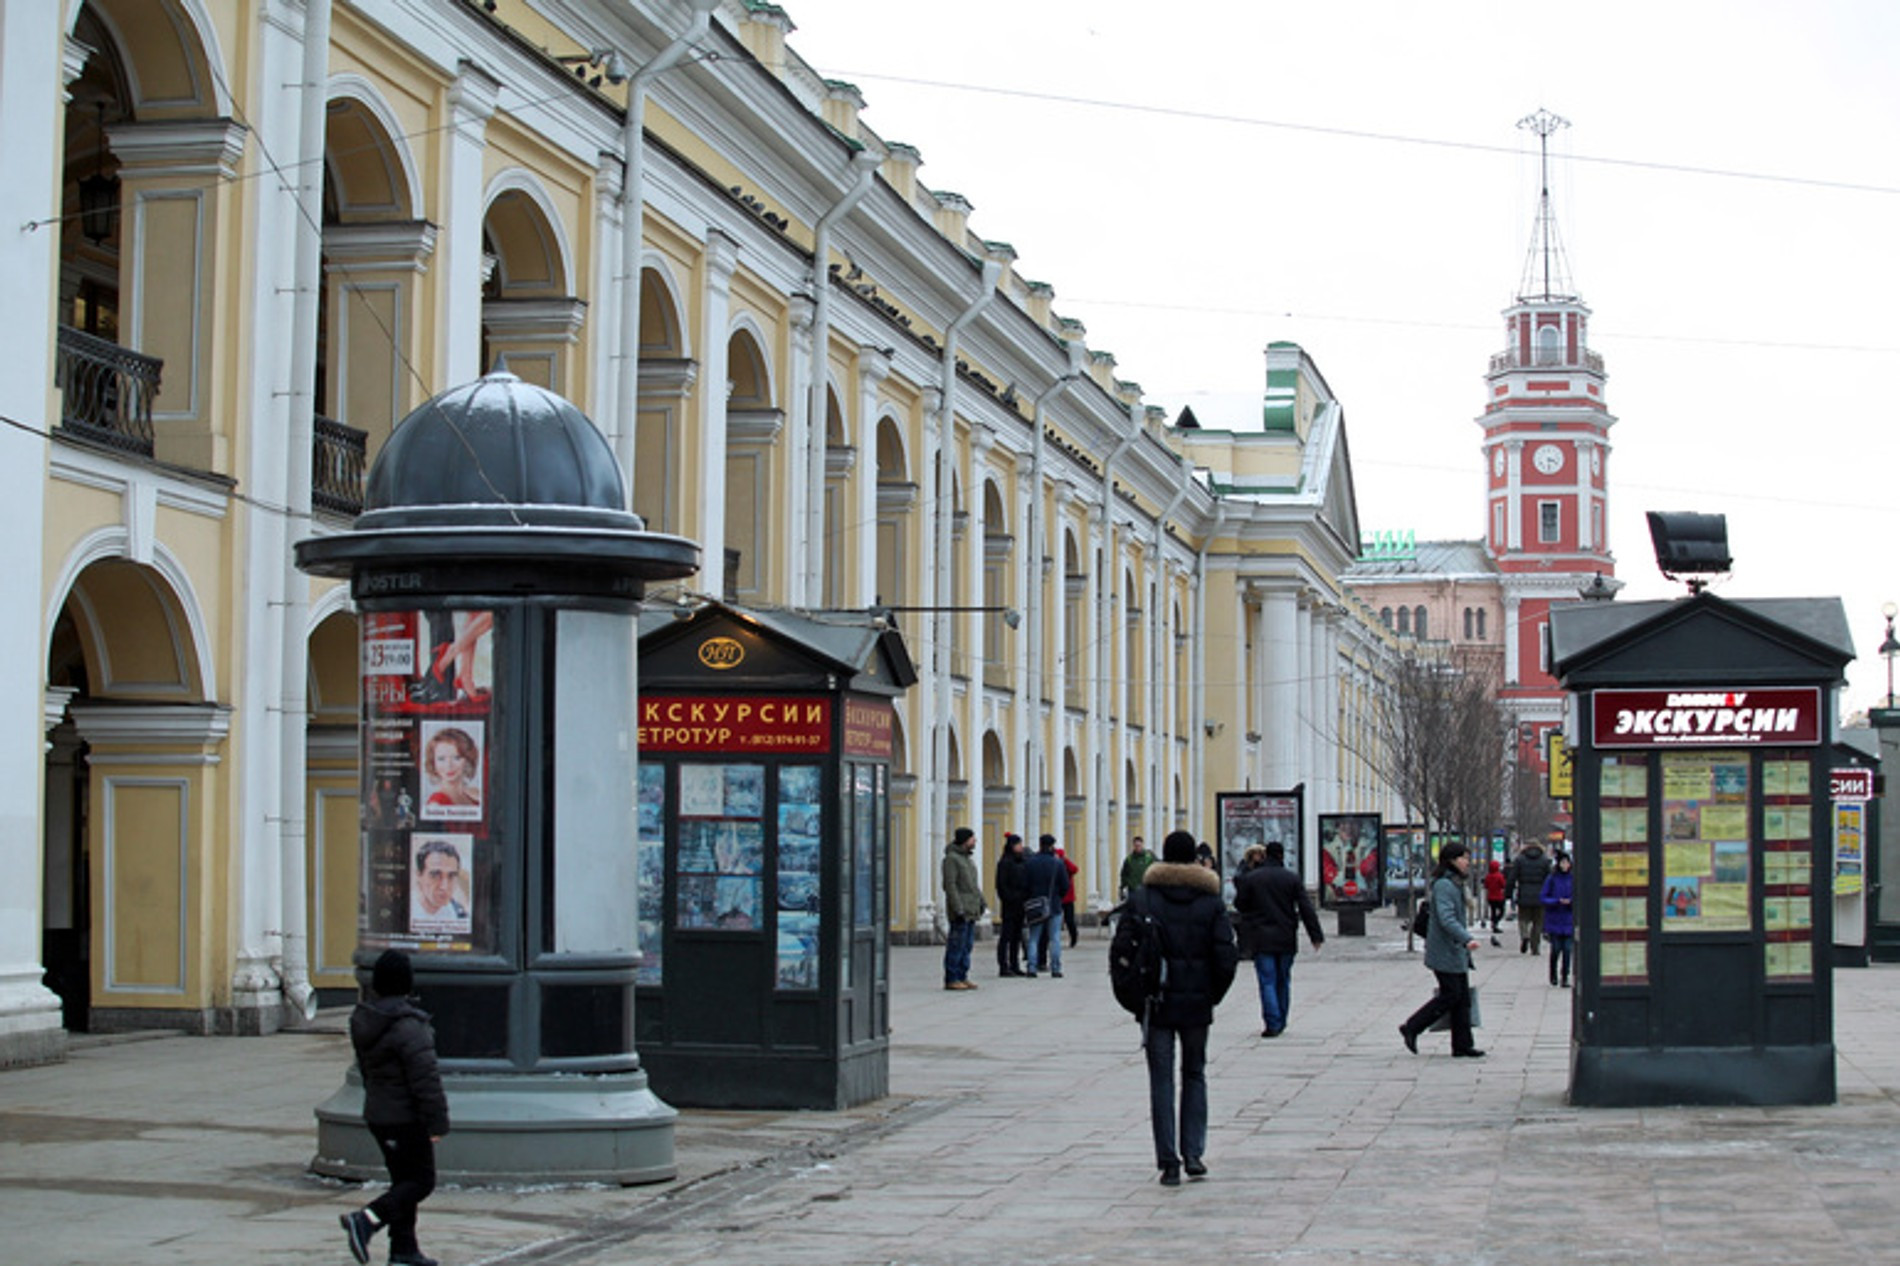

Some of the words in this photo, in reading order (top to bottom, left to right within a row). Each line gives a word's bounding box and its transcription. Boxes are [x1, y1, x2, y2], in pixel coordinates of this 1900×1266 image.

[645, 703, 822, 723] КСКУРСИИ
[1614, 707, 1799, 735] ЭКСКУРСИИ
[637, 727, 732, 744] ЕТРОТУР
